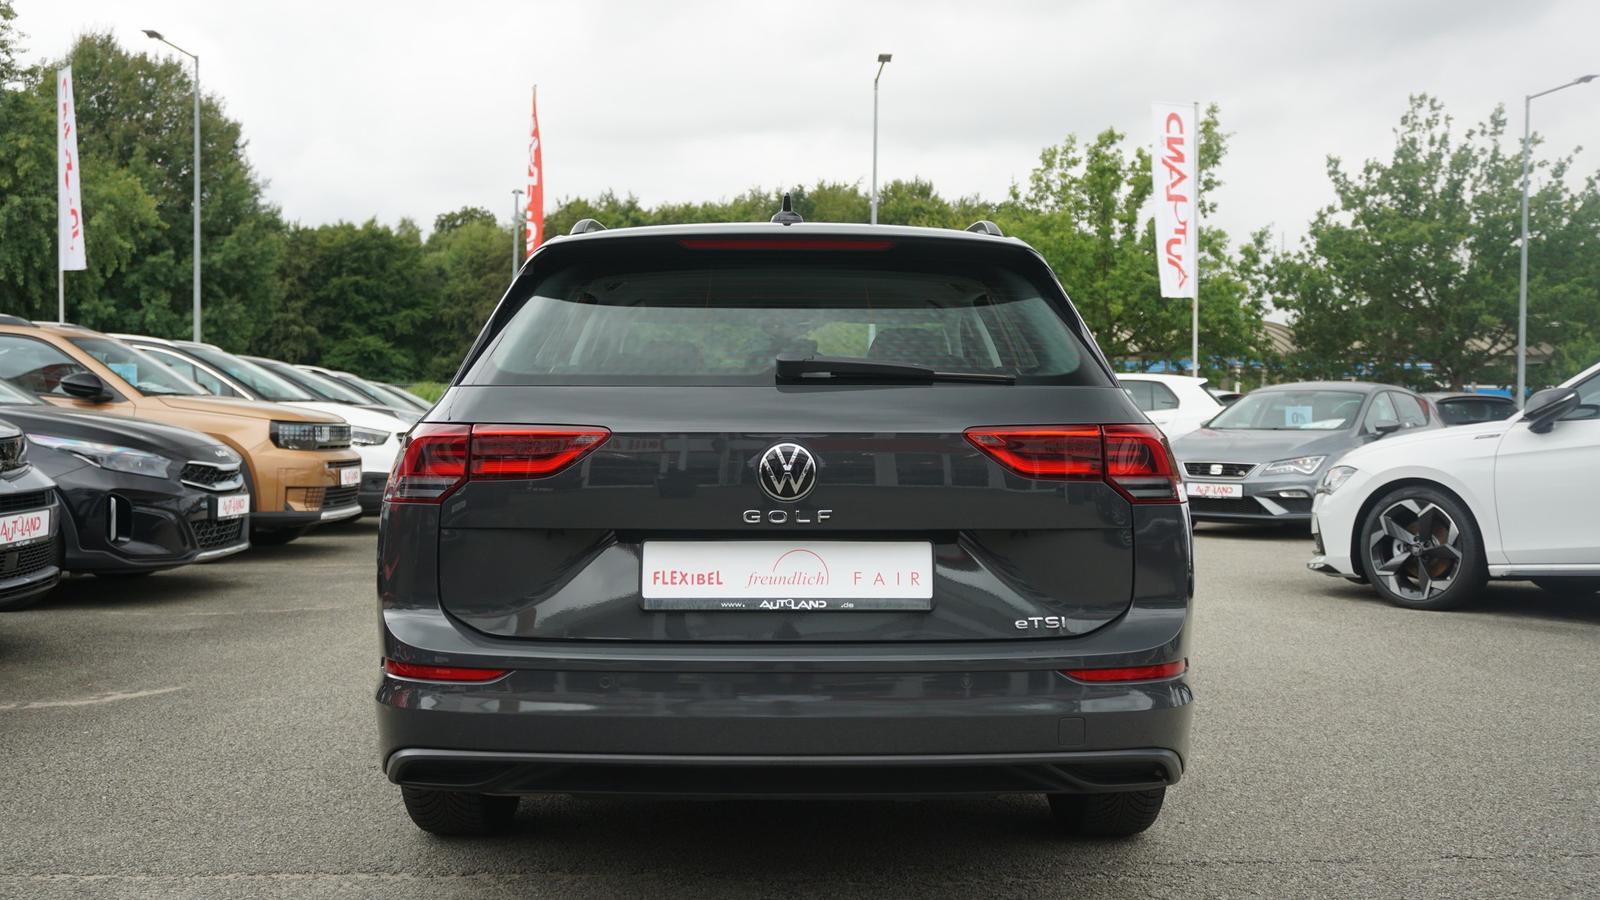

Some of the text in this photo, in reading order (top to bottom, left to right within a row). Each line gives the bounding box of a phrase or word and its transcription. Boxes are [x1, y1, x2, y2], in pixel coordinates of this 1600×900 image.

[1195, 484, 1233, 496] AUTLAND
[743, 509, 833, 523] GOLF
[0, 515, 41, 541] AUTOLAND
[652, 570, 920, 589] FLEXIBEL freundlich FAIR
[759, 598, 827, 610] AUTOLAND
[1014, 616, 1066, 629] eTSI
